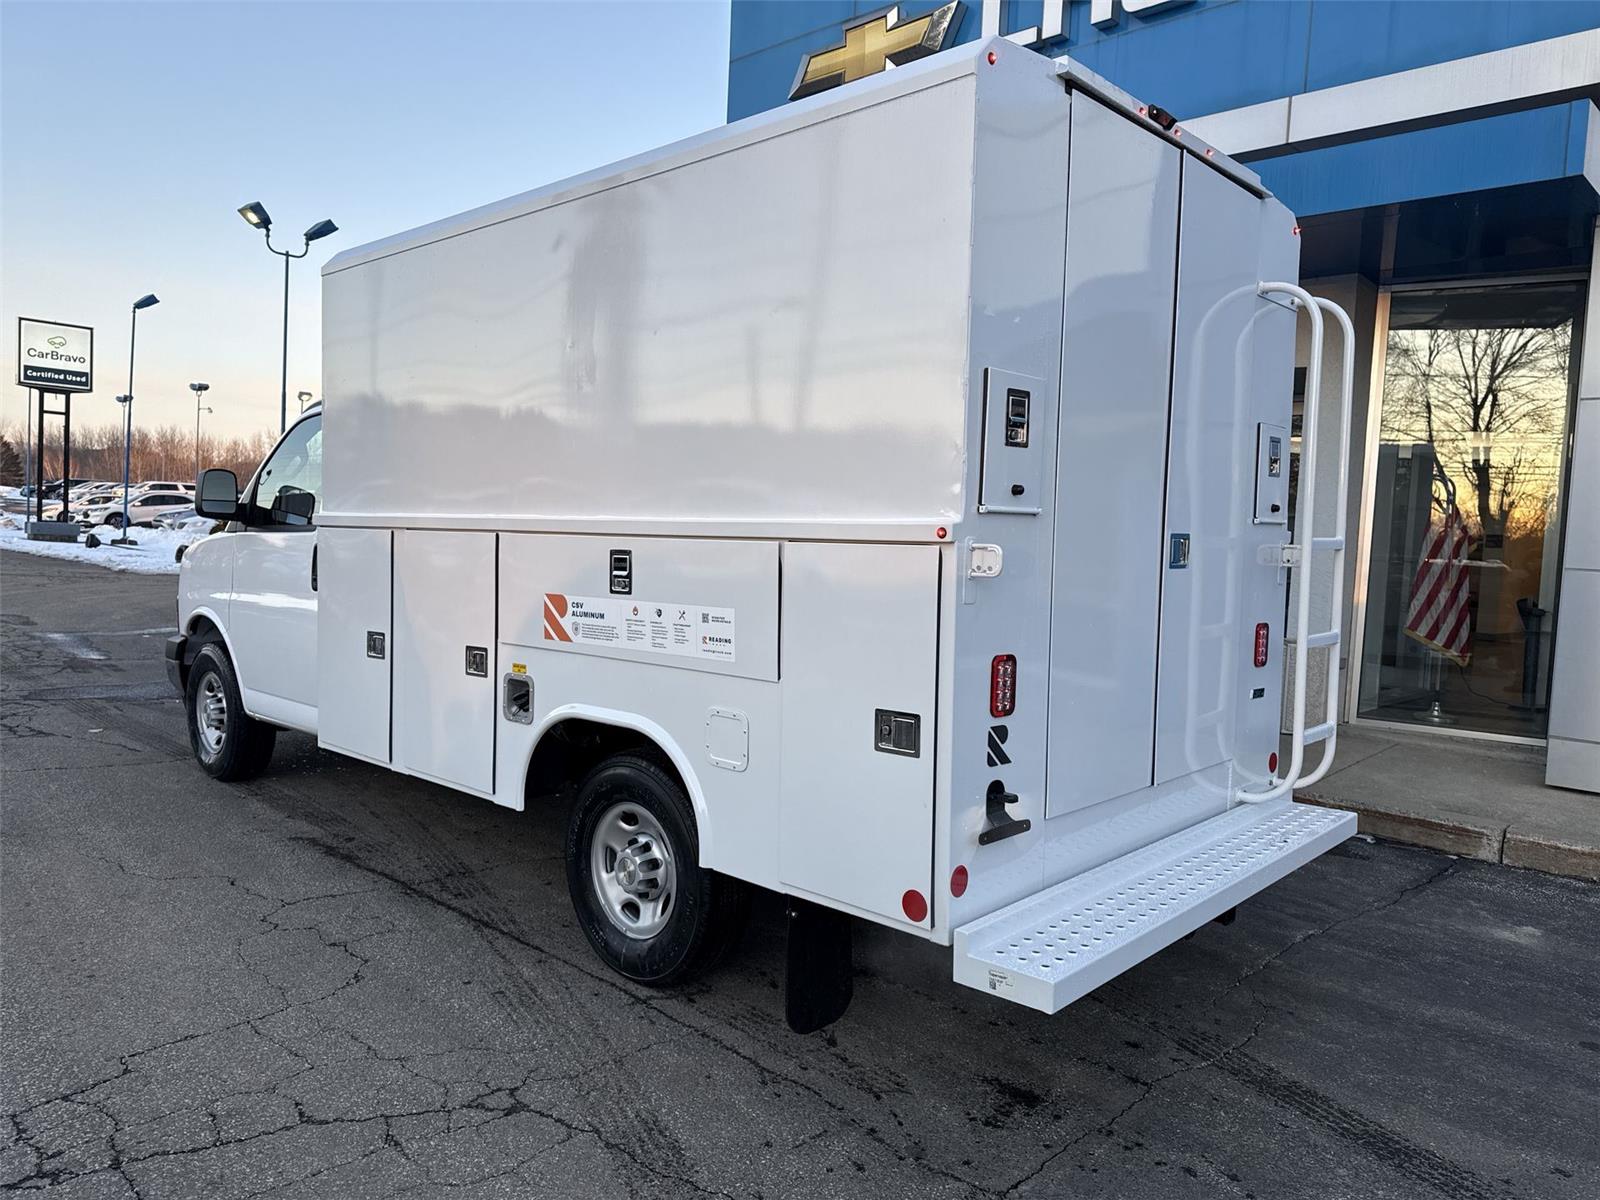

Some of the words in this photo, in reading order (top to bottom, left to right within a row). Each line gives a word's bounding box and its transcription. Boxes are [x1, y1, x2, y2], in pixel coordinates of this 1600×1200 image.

[27, 347, 87, 364] CarBravo
[26, 370, 65, 379] Certified
[66, 374, 87, 382] Used
[571, 601, 584, 609] CSV
[571, 610, 605, 619] ALUMINUM
[709, 636, 732, 645] READING
